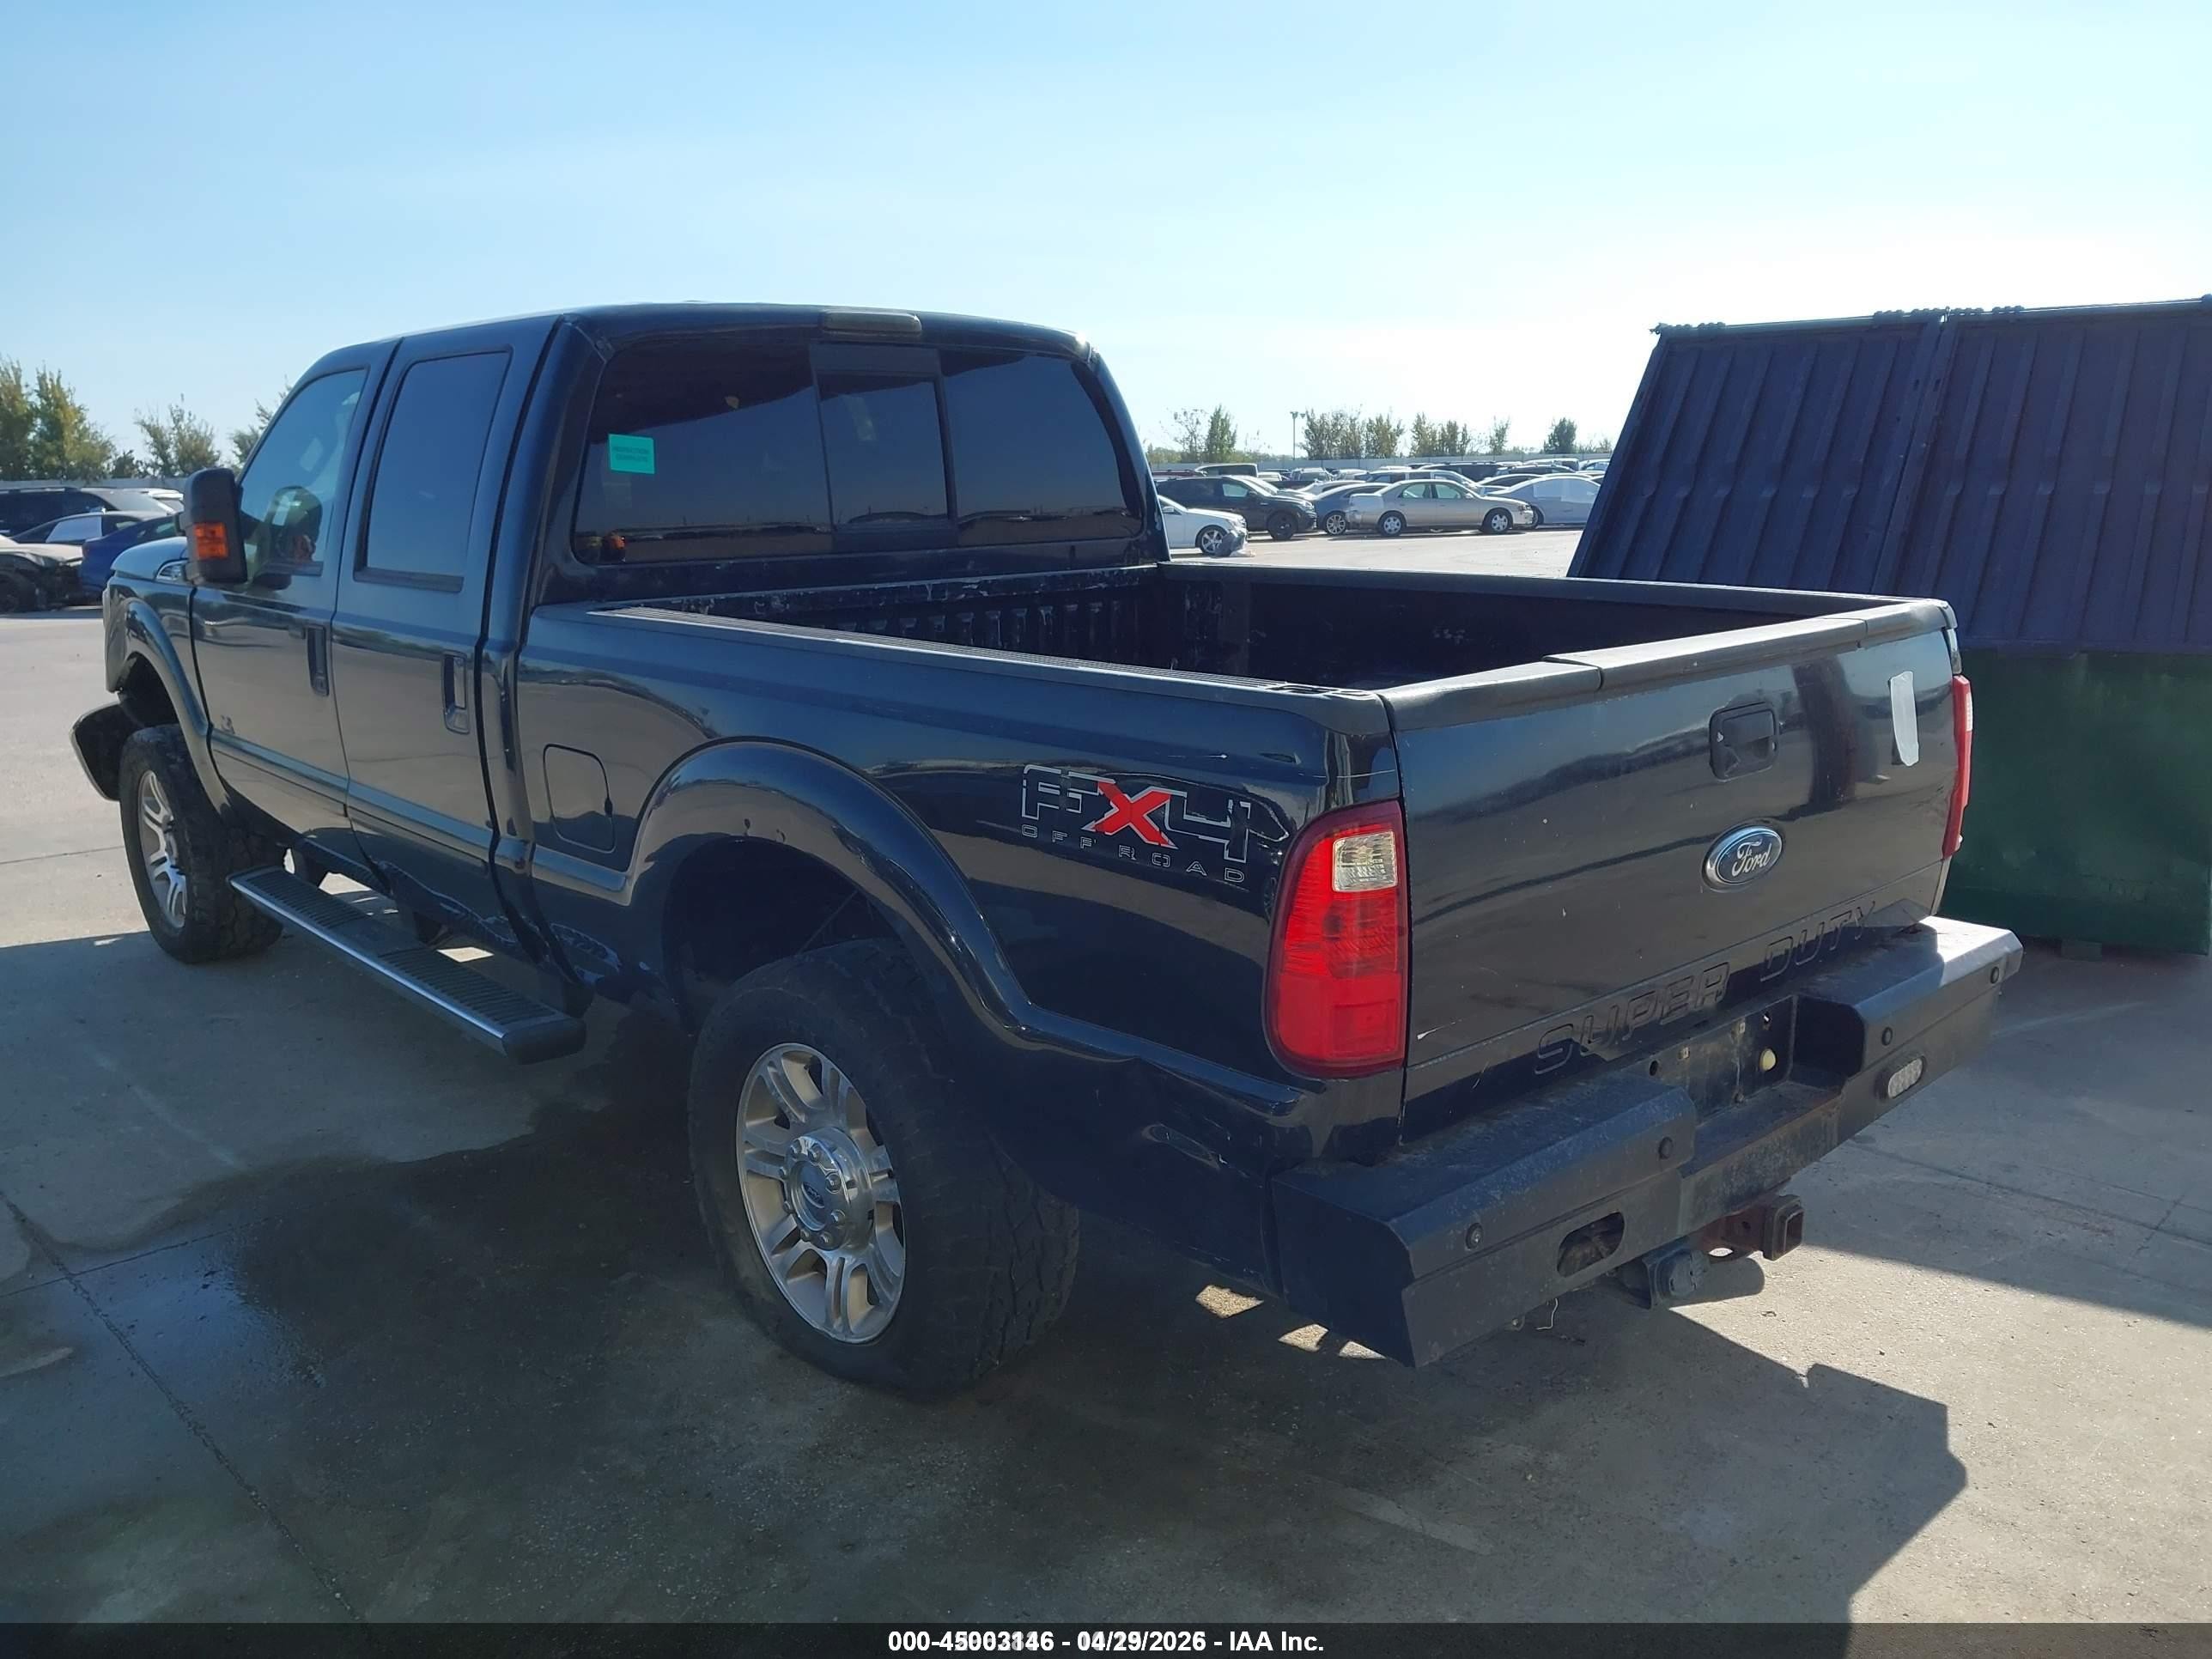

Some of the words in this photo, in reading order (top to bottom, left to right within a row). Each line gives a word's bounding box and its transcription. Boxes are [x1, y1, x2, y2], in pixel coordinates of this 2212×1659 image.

[1021, 763, 1251, 864] FX4
[1021, 823, 1096, 848] OFF
[1118, 844, 1245, 883] ROAD
[1731, 838, 1772, 877] Ford
[1534, 961, 1731, 1075] SUPER
[1759, 901, 1876, 982] DUTY
